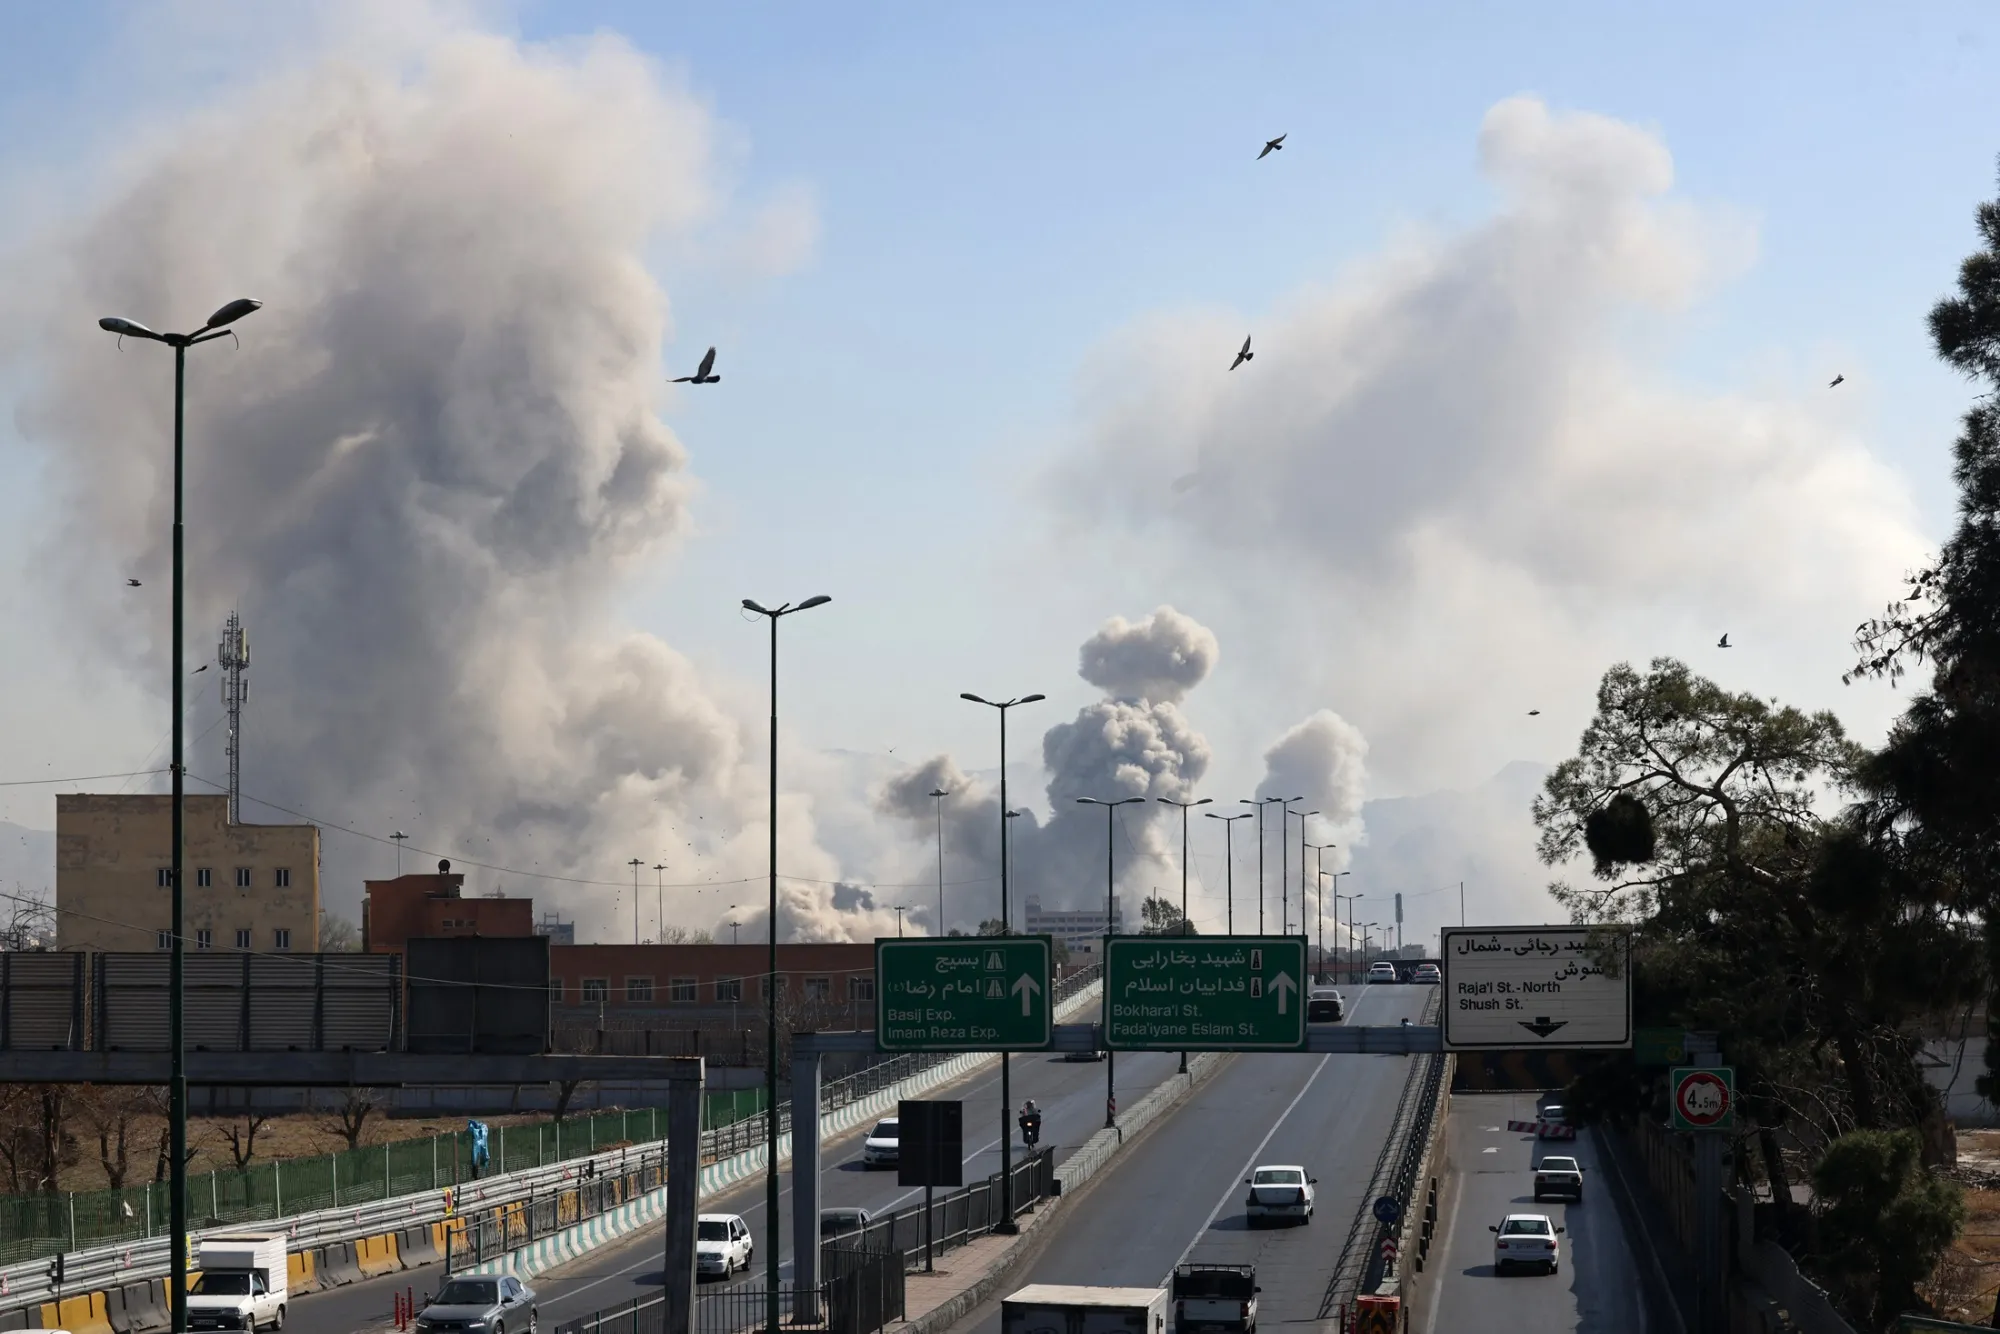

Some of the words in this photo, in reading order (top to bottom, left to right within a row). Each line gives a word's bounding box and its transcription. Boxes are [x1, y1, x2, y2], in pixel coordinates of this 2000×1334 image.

[1458, 936, 1501, 954] شمال
[935, 955, 980, 973] بسیج
[1132, 950, 1196, 970] بخارایی
[1200, 949, 1246, 967] شهید
[942, 979, 980, 1000] امام
[1125, 978, 1174, 997] اسلام
[1179, 976, 1245, 996] فداییان
[1183, 1004, 1203, 1017] St.
[1460, 998, 1499, 1010] Shush
[1506, 998, 1523, 1009] St.
[888, 1009, 922, 1023] Basij
[926, 1008, 956, 1022] Exp.
[888, 1027, 926, 1039] Imam
[931, 1026, 966, 1038] Reza
[970, 1026, 1000, 1040] Exp.
[1112, 1023, 1187, 1038] Fada'iyane
[1192, 1023, 1234, 1035] Eslam
[1238, 1023, 1259, 1035] St.
